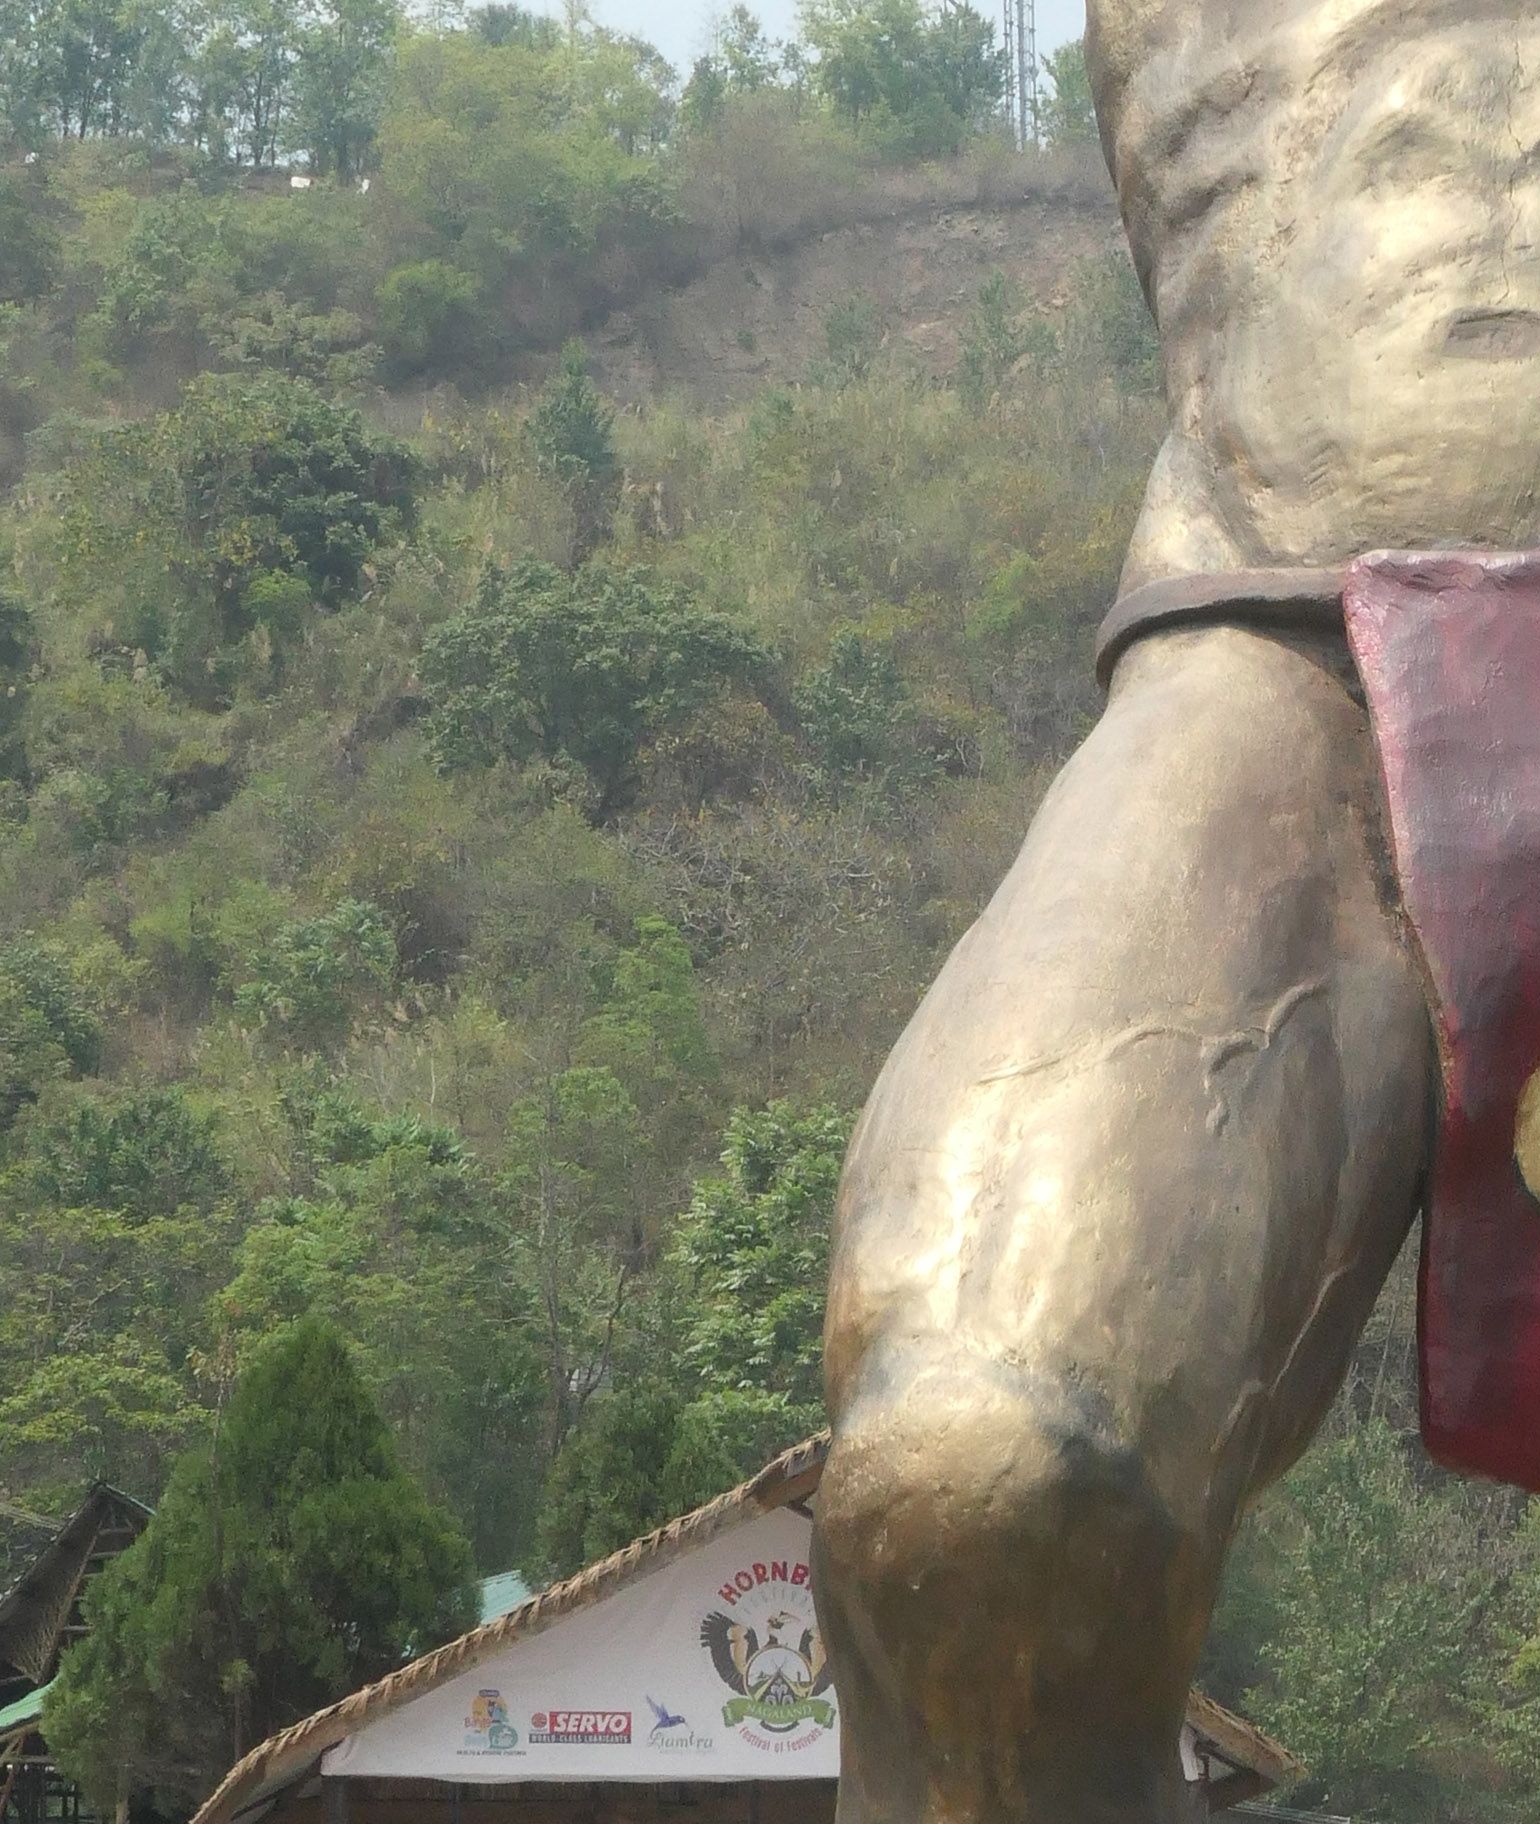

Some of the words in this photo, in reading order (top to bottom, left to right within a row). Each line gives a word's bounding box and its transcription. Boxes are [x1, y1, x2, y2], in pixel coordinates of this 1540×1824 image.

[718, 1561, 812, 1606] HORNB
[747, 1702, 813, 1719] NAGALAND
[553, 1713, 628, 1733] SERVO
